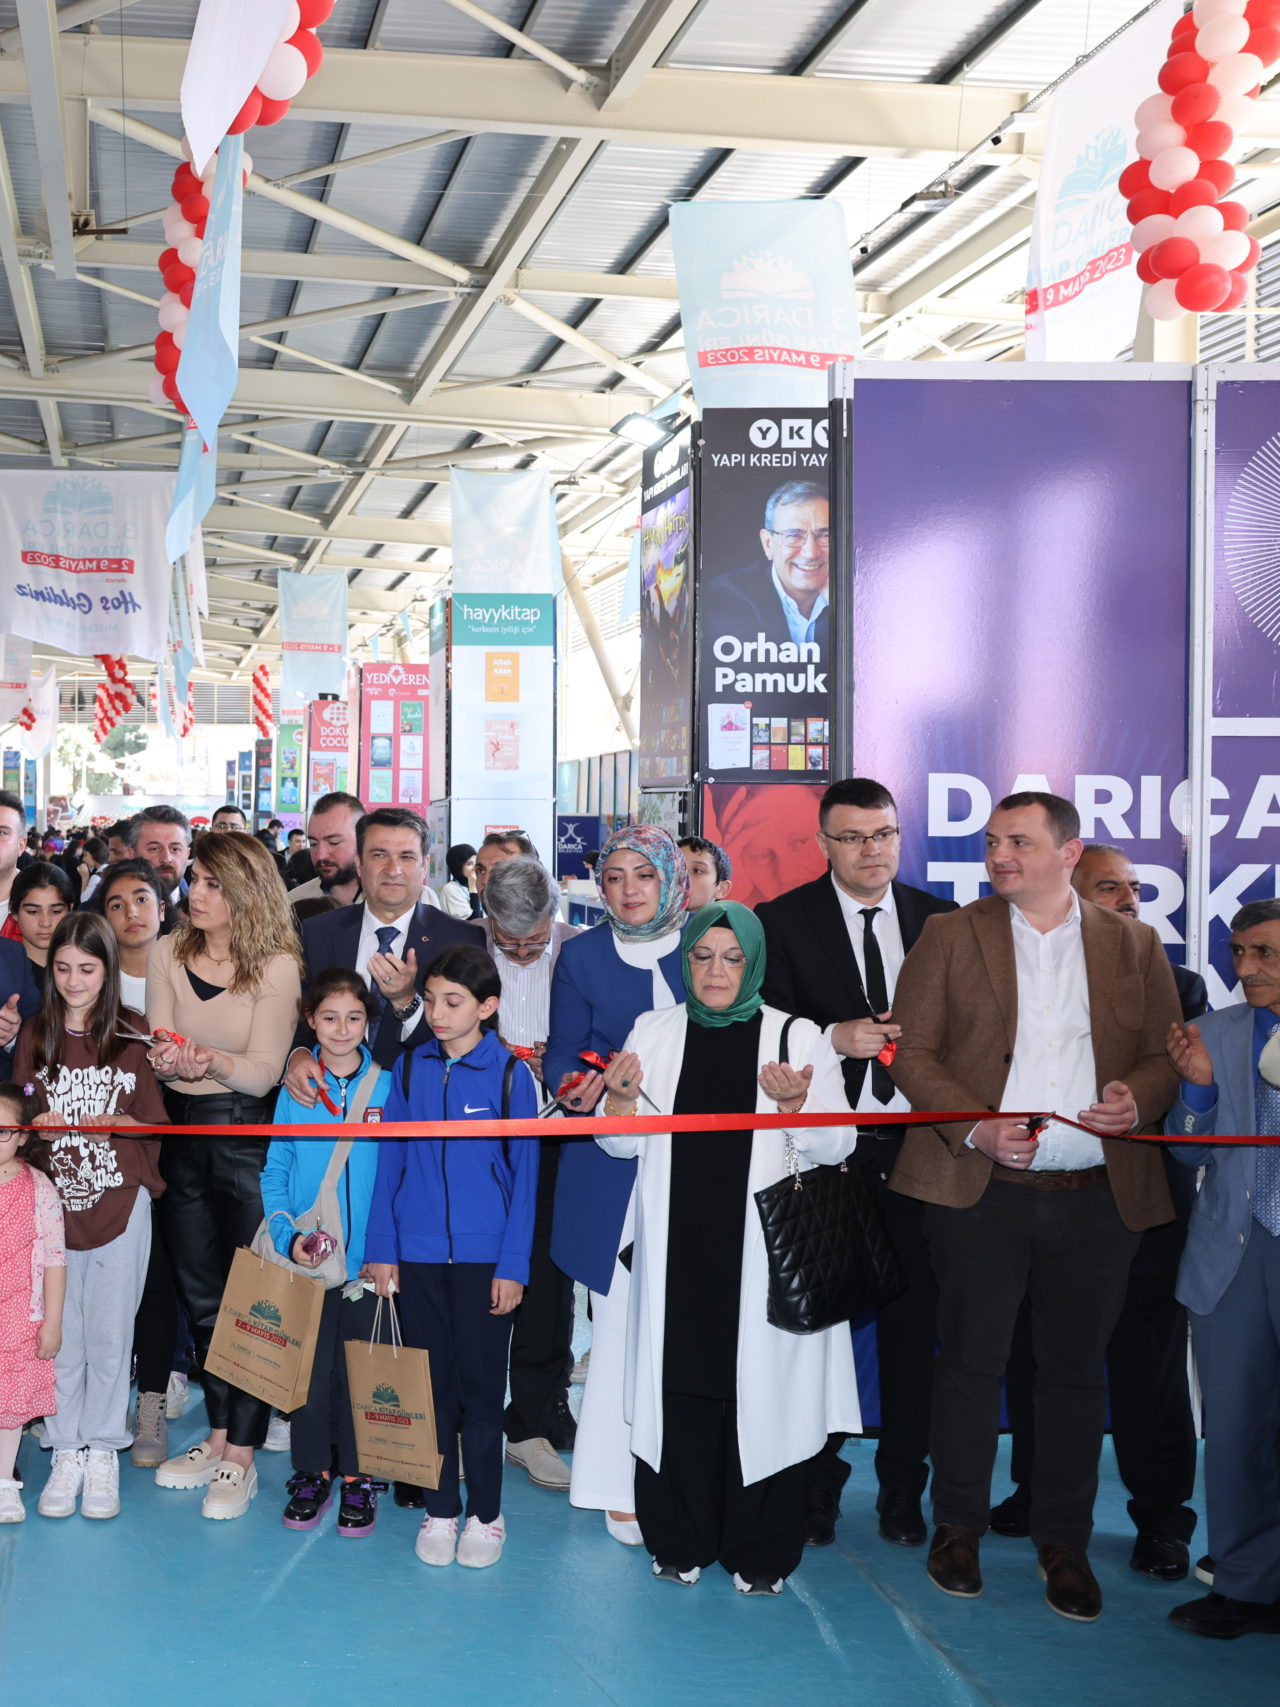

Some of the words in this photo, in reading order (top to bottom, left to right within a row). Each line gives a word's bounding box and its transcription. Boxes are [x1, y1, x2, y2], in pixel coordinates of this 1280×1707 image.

[711, 453, 746, 467] YAPI
[749, 451, 797, 467] KREDİ
[800, 453, 828, 467] YAY
[463, 604, 541, 624] hayykitap
[713, 632, 821, 663] Orhan
[715, 664, 828, 693] Pamuk
[56, 1065, 113, 1094] DOING
[251, 1326, 270, 1340] MAYIS
